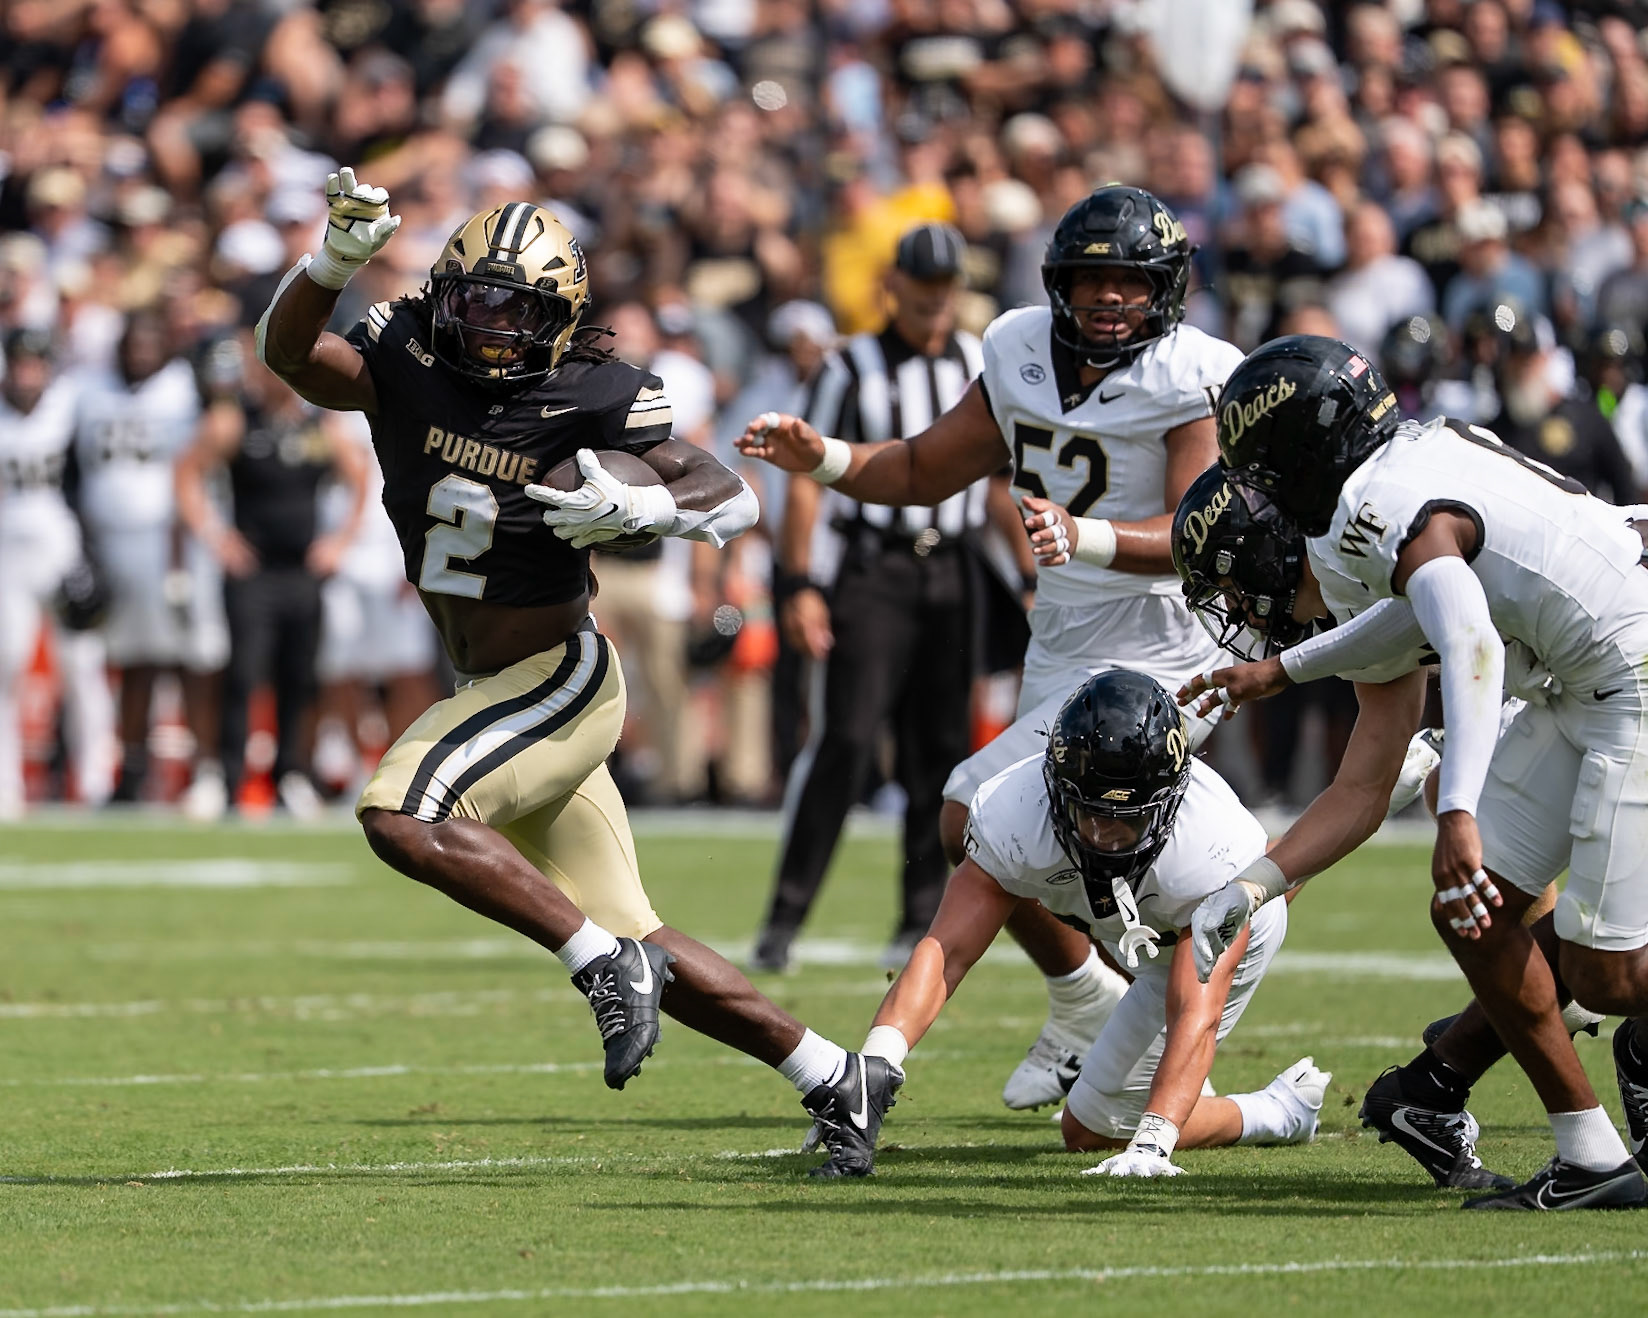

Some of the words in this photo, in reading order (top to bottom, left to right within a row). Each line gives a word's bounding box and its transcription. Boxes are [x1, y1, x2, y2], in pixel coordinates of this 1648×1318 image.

[1223, 376, 1297, 447] Deacs
[423, 424, 539, 486] PURDUE
[1013, 419, 1111, 538] 52
[418, 473, 500, 601] 2
[1338, 501, 1389, 559] WF
[1100, 788, 1132, 802] ACC
